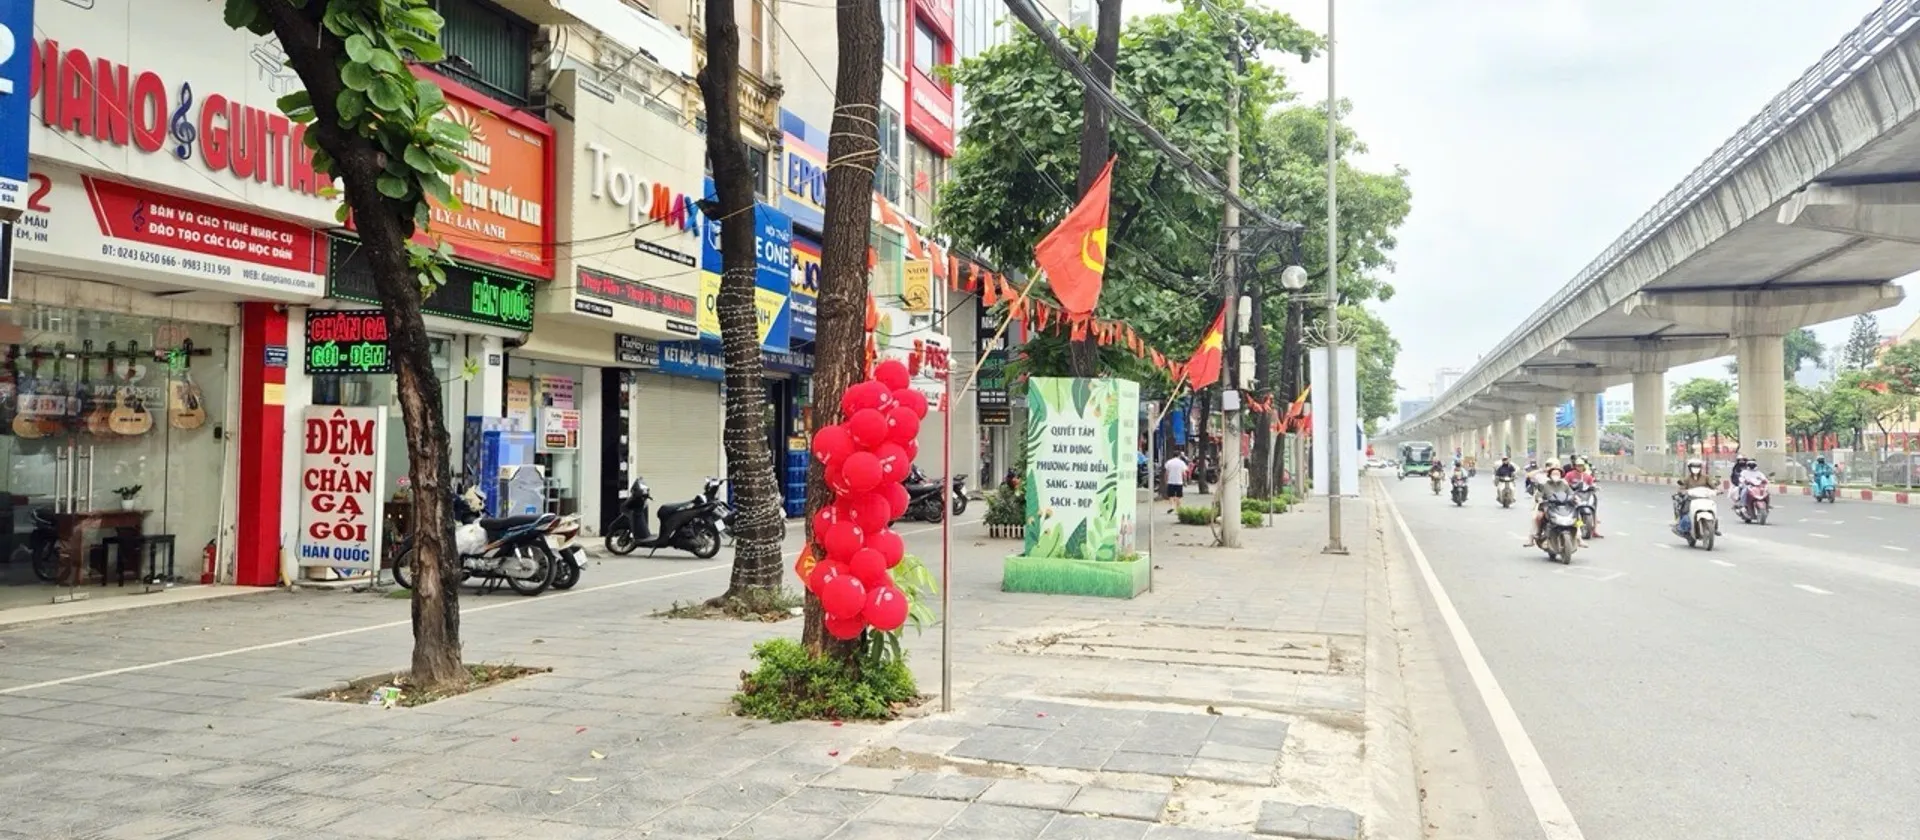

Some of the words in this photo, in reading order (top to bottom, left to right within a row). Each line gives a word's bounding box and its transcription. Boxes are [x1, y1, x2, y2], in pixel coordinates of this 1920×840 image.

[197, 214, 220, 228] CHO
[177, 228, 201, 243] TẠO
[248, 242, 270, 256] HỌC
[765, 240, 790, 267] ONE
[362, 316, 387, 341] GA
[306, 408, 375, 464] ĐỆM
[304, 462, 373, 493] CHĂN
[1075, 480, 1098, 490] XANH
[309, 514, 367, 541] GỐI
[302, 541, 330, 558] HÀN
[333, 543, 370, 562] QUỐC
